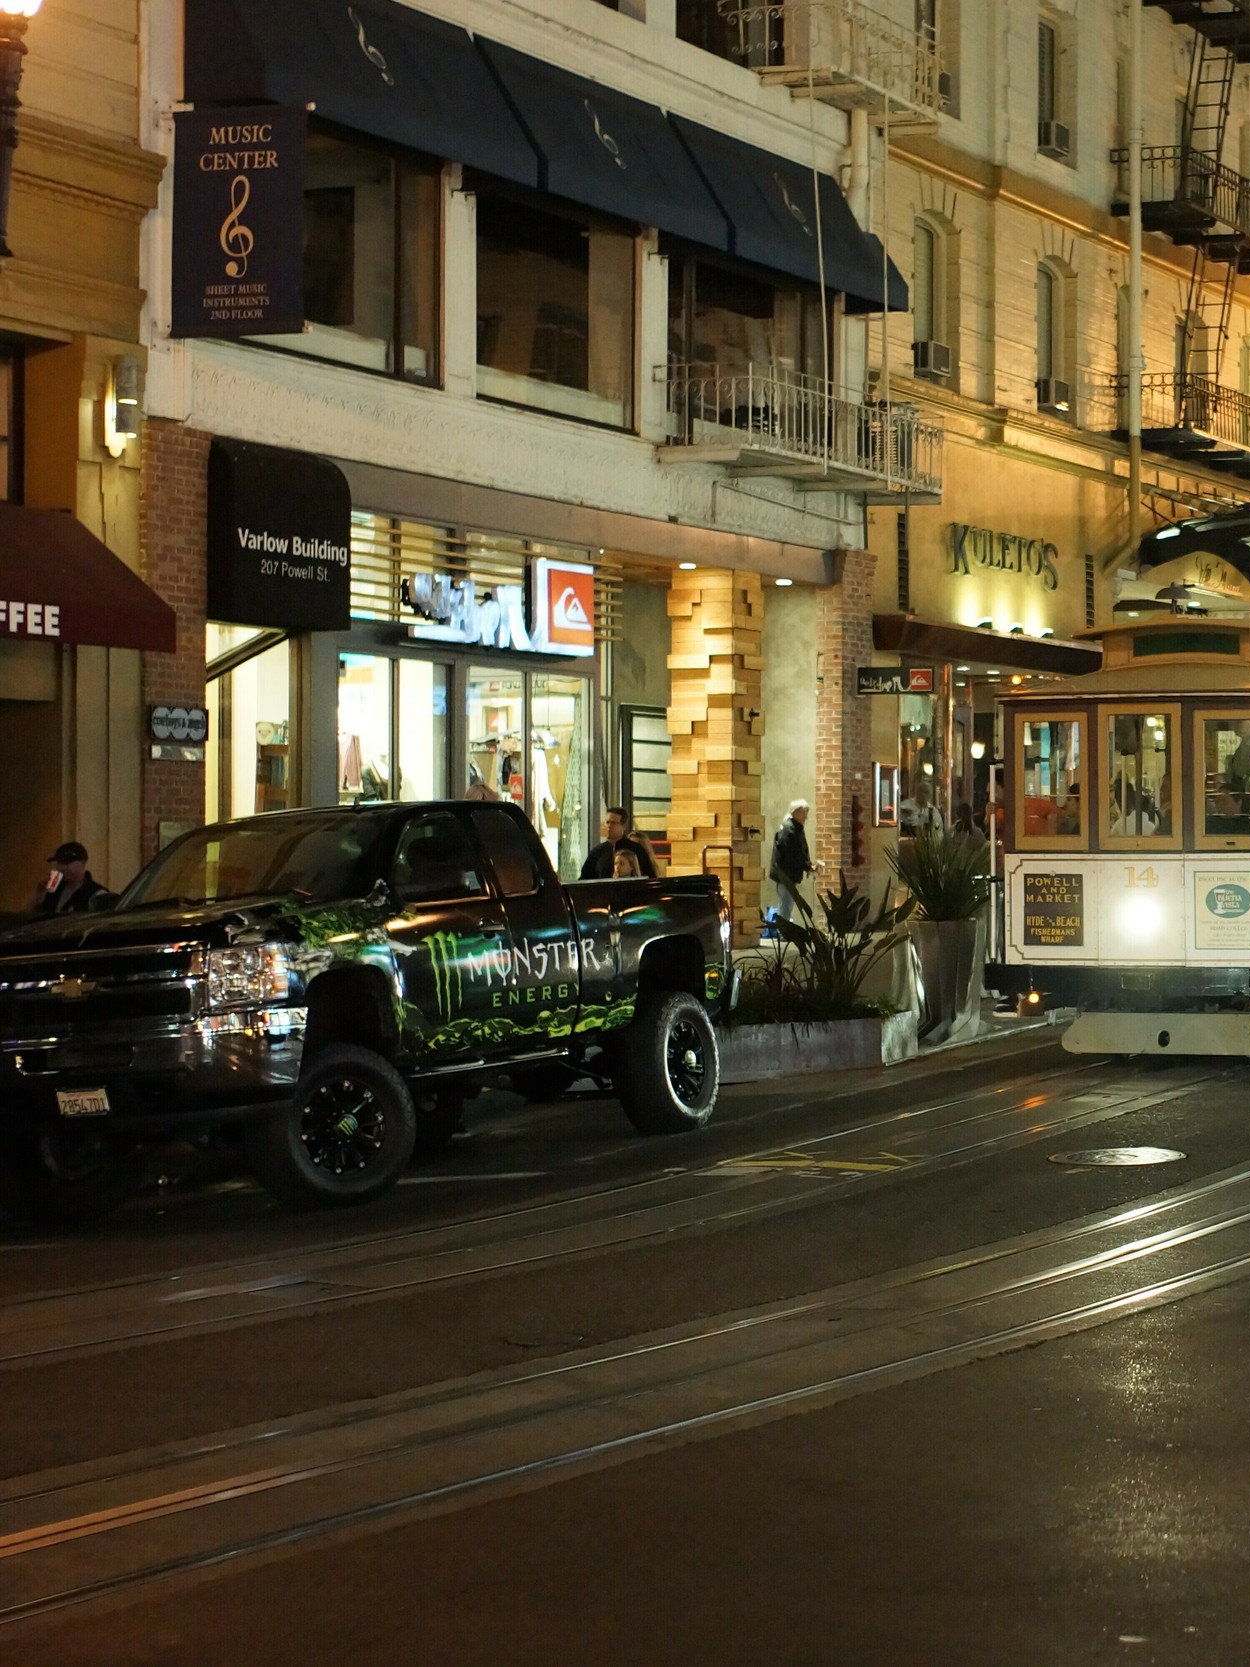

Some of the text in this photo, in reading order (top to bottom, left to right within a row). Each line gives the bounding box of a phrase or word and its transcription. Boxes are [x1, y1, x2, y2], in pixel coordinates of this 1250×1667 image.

[208, 125, 273, 145] MUSIC
[200, 150, 279, 172] CENTER
[205, 283, 267, 295] SHEET MUSIC
[203, 296, 270, 307] INSTRUMENTS
[210, 309, 263, 320] 2ND FLOOR
[237, 527, 348, 567] Varlow Building
[949, 522, 1059, 591] KULETO'S
[260, 559, 331, 582] 207 Powell St.
[1026, 878, 1080, 887] POWELL
[1124, 866, 1159, 888] 14
[1026, 894, 1080, 903] MARKET
[1026, 915, 1045, 926] HYDE
[1056, 915, 1081, 926] BEACH
[467, 938, 601, 987] MONSTER
